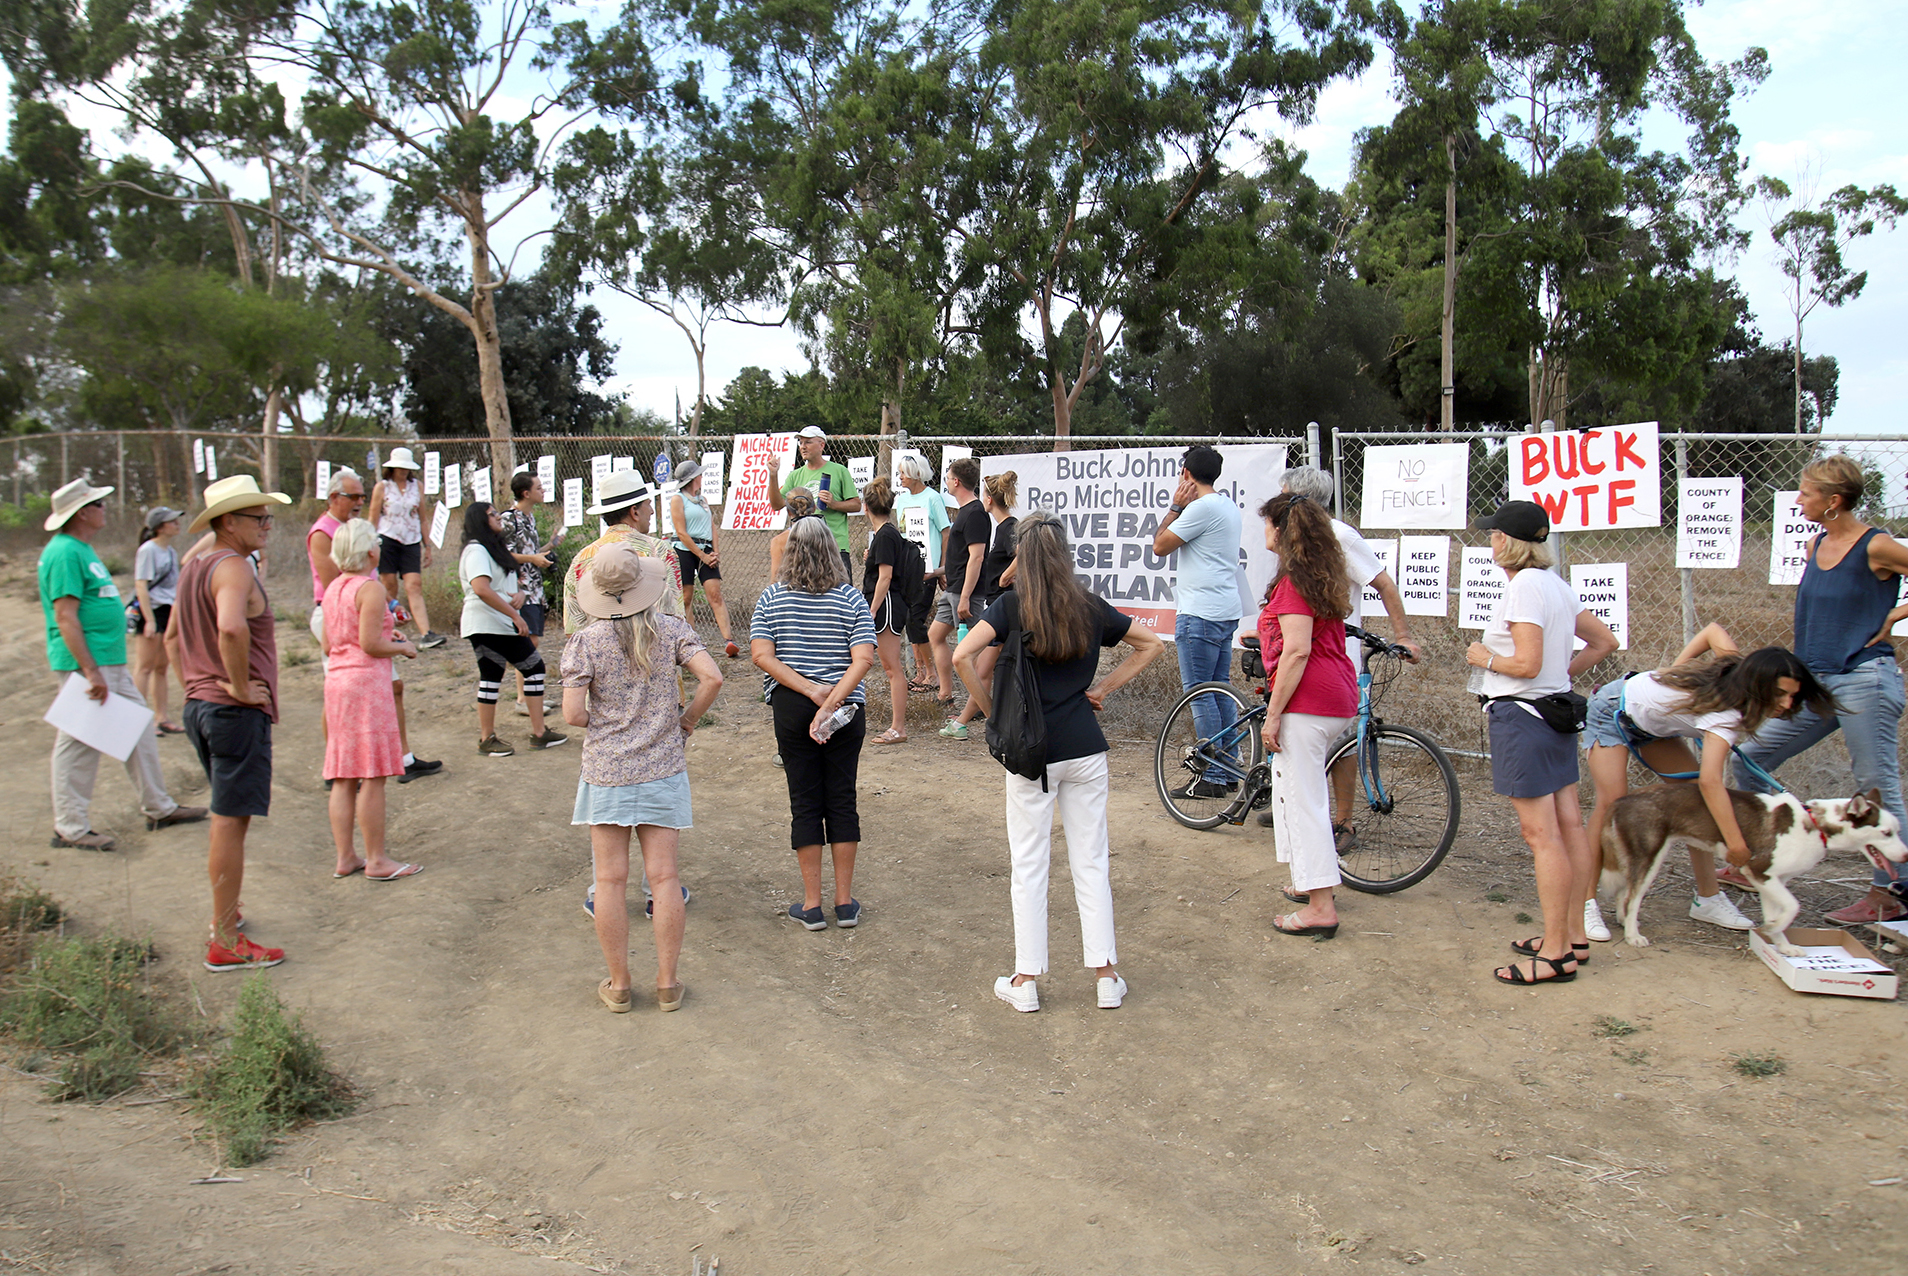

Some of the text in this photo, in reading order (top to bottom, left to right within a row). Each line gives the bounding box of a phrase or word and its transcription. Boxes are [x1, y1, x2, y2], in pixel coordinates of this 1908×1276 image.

[740, 437, 790, 453] MICHELLE
[1521, 430, 1646, 486] BUCK
[1057, 451, 1187, 481] Buck Johns
[1398, 459, 1426, 478] NO
[741, 469, 768, 485] STO
[1687, 489, 1731, 497] COUNTY
[1027, 482, 1170, 514] Rep Michelle
[1382, 484, 1445, 512] FENCE!
[1532, 480, 1636, 526] WTF
[733, 516, 772, 529] BEACH
[1686, 514, 1733, 522] ORANGE:
[1061, 513, 1160, 539] IVE BA
[1687, 527, 1732, 535] REMOVE
[1411, 552, 1436, 560] KEEP
[1689, 552, 1726, 560] FENCE!
[1468, 557, 1493, 565] COUN
[1406, 565, 1440, 573] PUBLIC
[1480, 569, 1493, 577] OF
[1407, 578, 1439, 586] LANDS
[1467, 580, 1505, 589] ORANGE:
[1583, 578, 1615, 588] TAKE
[1404, 591, 1441, 600] PUBLIC!
[1467, 591, 1504, 600] REMOVE
[1580, 593, 1616, 603] DOWN
[1475, 603, 1493, 611] THE
[1469, 614, 1492, 622] FENC
